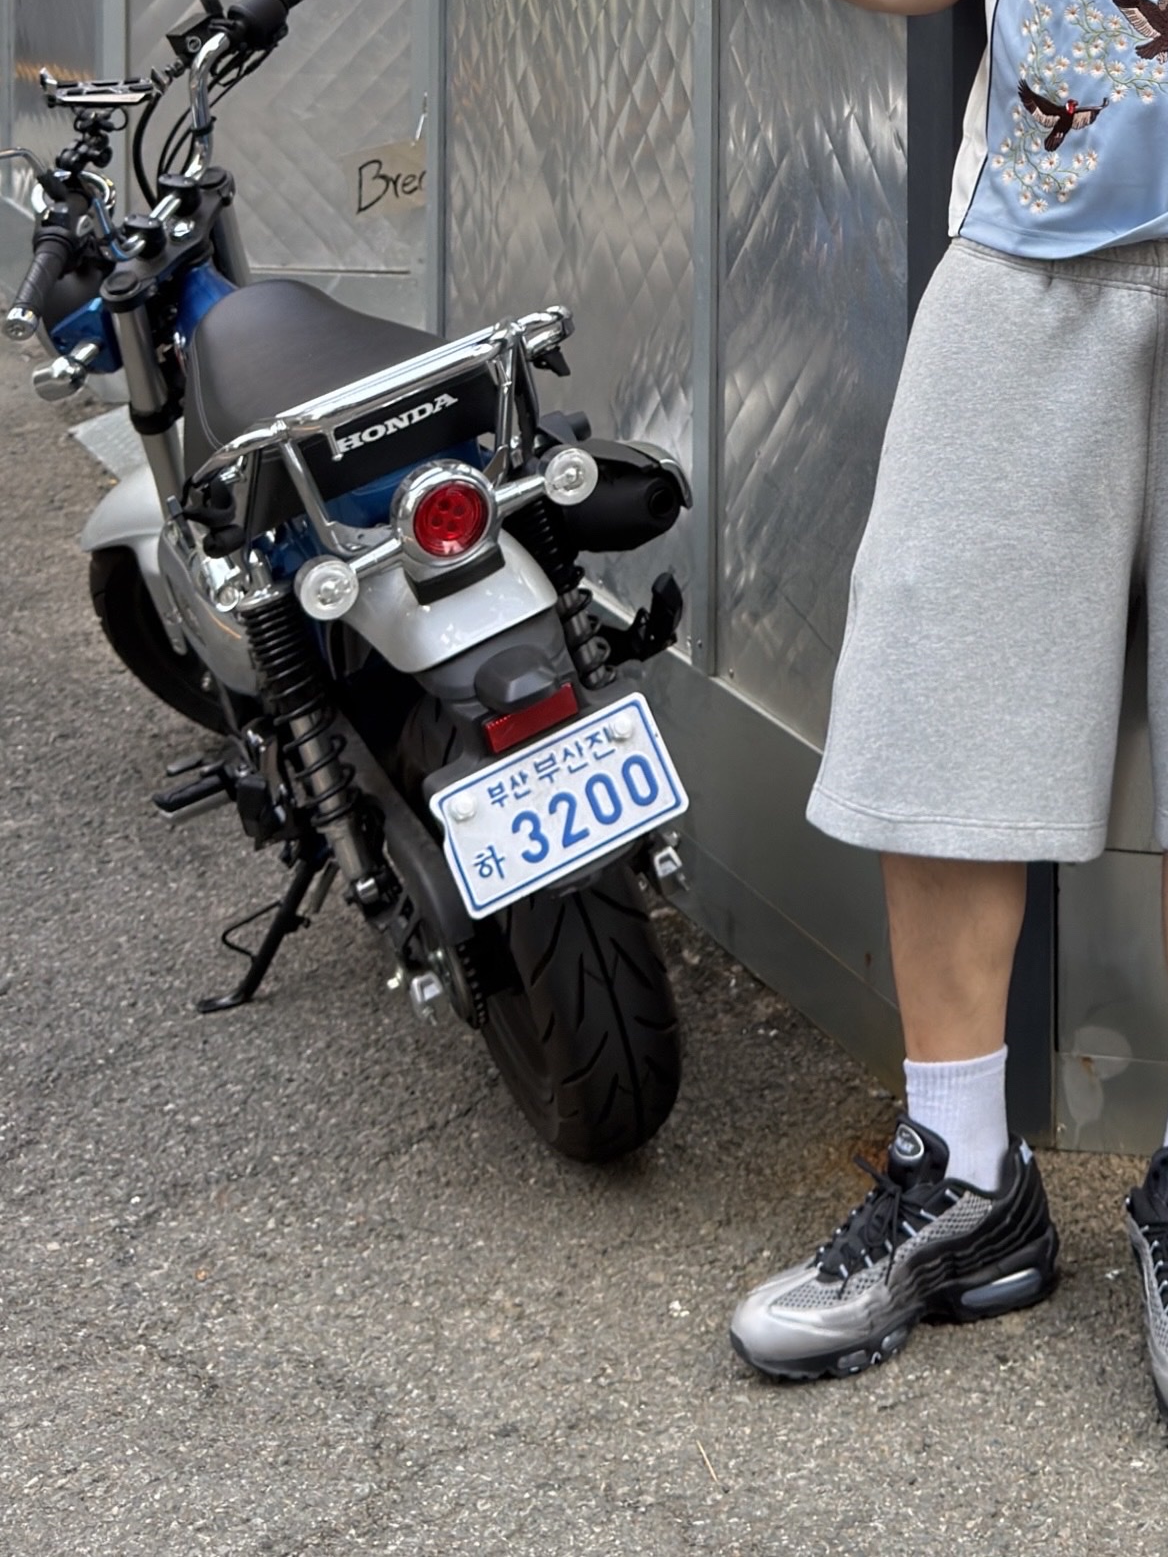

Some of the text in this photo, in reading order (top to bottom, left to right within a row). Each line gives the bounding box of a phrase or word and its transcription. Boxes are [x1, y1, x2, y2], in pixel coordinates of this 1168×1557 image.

[337, 393, 458, 455] HONDA
[487, 726, 617, 807] 부산 부산진
[473, 754, 659, 879] 하 3200
